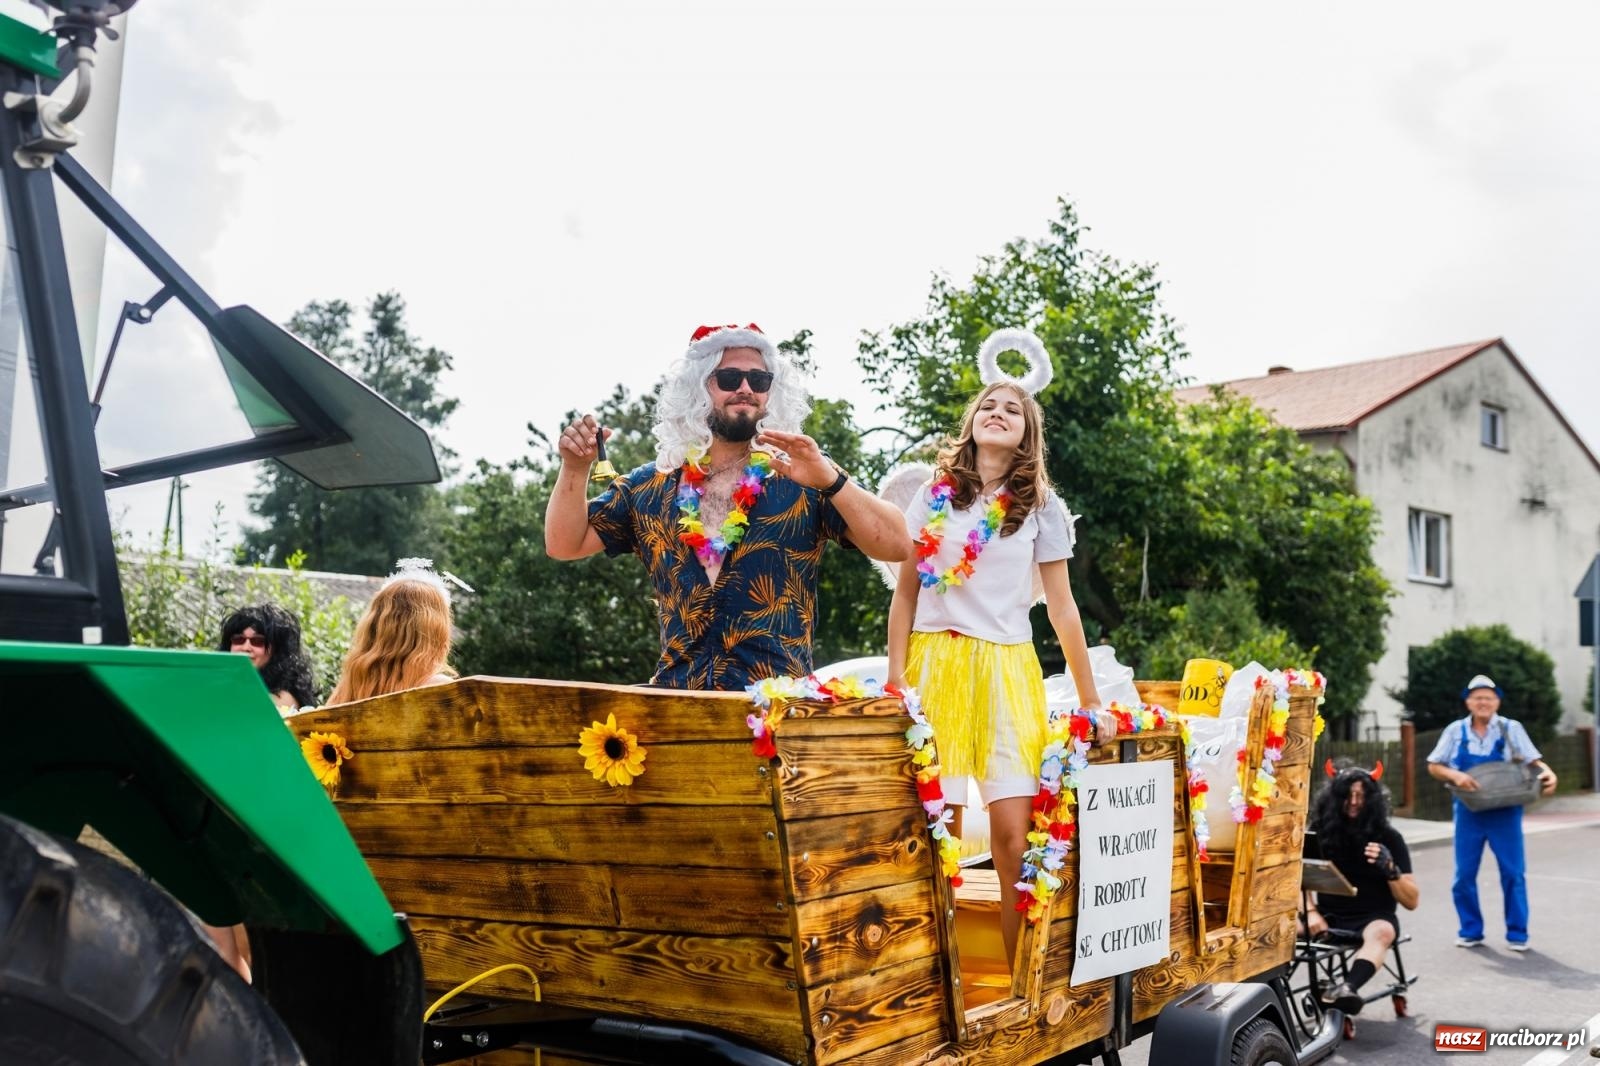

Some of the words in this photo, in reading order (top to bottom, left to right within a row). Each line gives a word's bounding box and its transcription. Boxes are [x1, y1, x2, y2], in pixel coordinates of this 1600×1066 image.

[1181, 684, 1208, 701] ÓD
[1087, 788, 1098, 811] Z
[1098, 828, 1157, 857] WRACOMY
[1093, 876, 1147, 907] ROBOTY
[1078, 935, 1093, 958] SE
[1101, 919, 1163, 953] CHYTOMY
